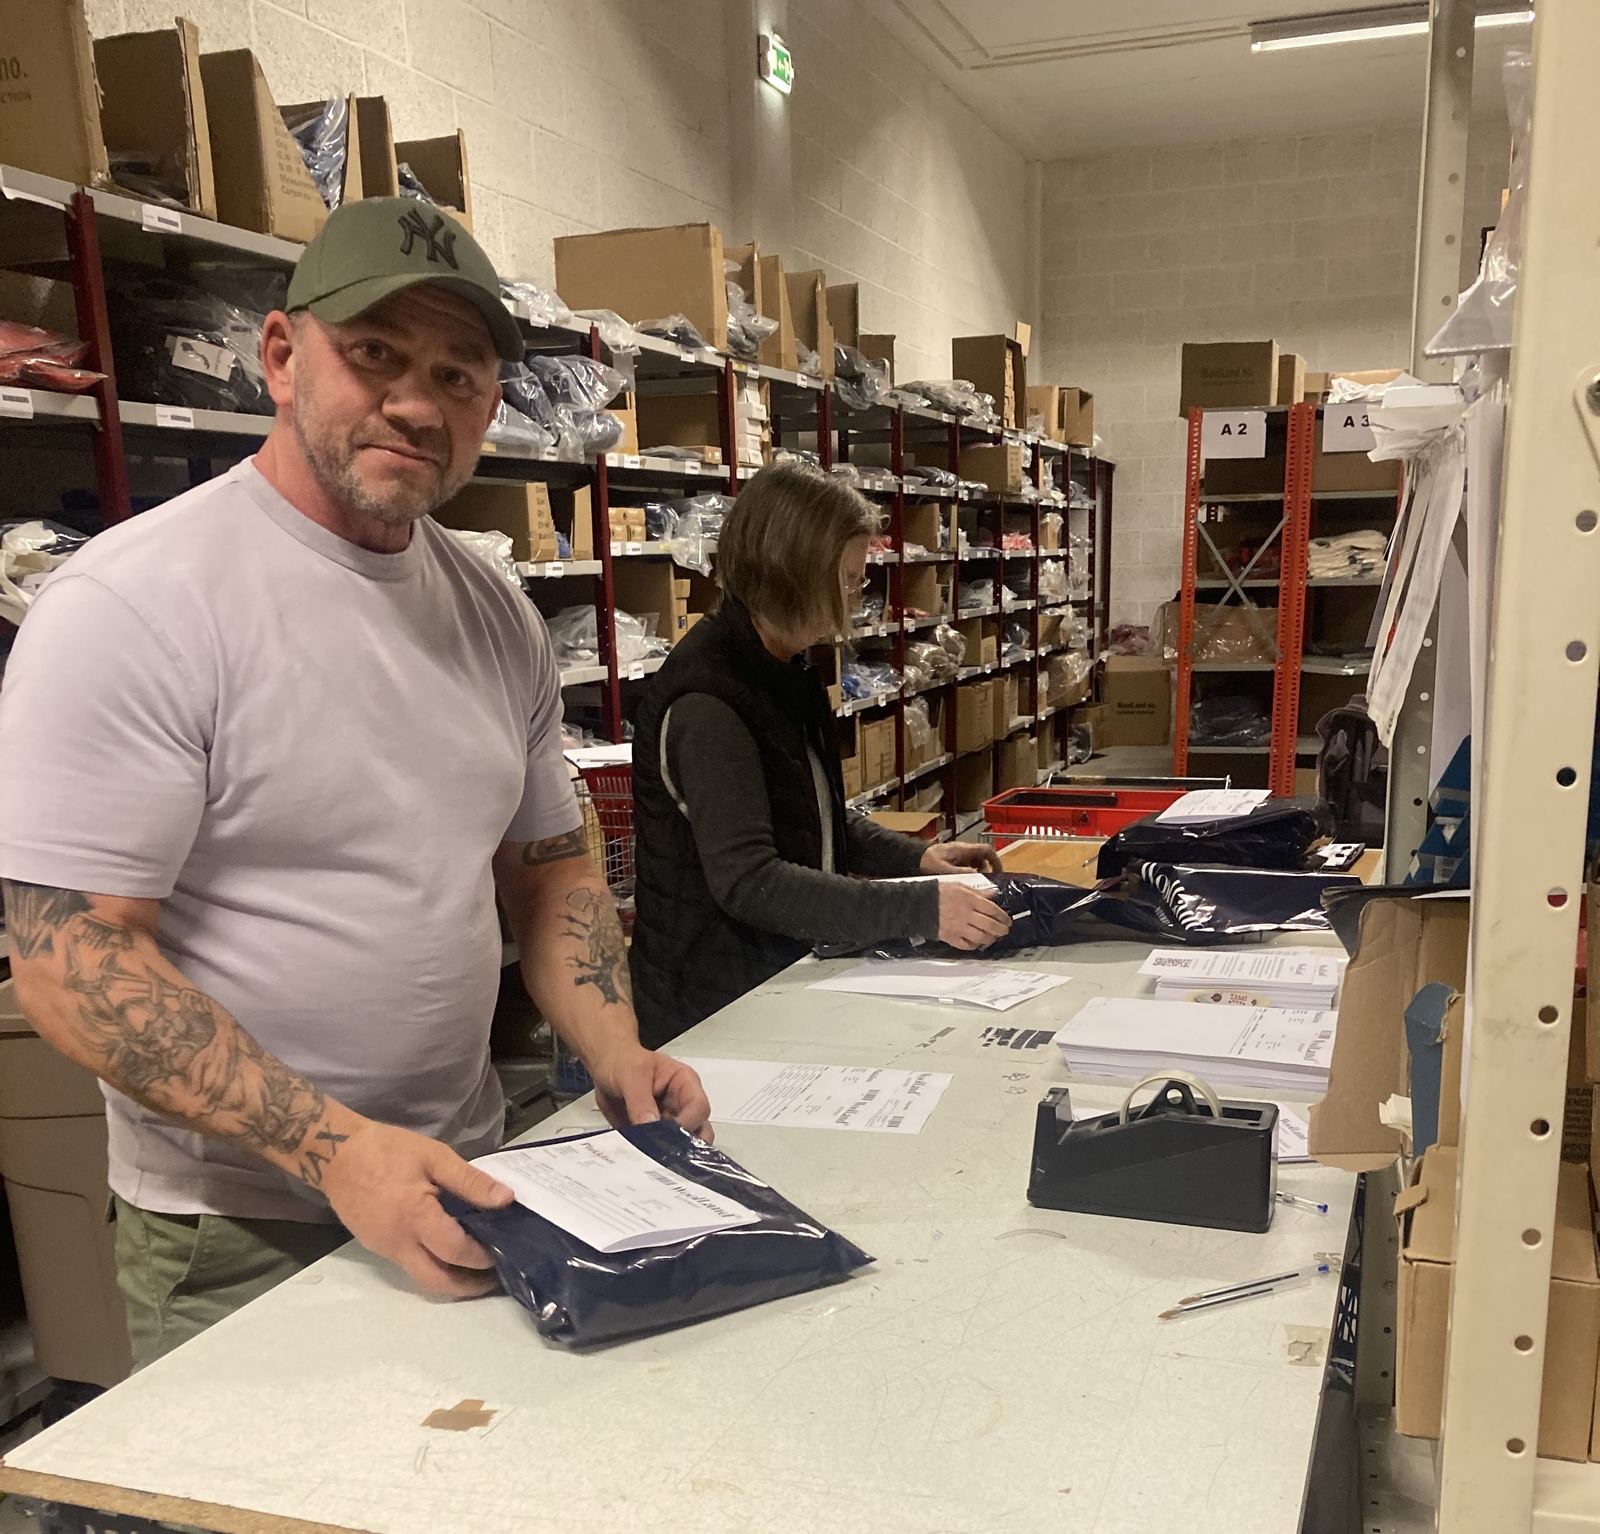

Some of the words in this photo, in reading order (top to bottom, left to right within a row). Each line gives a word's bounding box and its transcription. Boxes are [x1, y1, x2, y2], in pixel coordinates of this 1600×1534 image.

[398, 207, 458, 270] NY
[1343, 415, 1355, 428] A
[1361, 414, 1370, 427] 3
[1221, 423, 1232, 435] A
[1238, 423, 1247, 435] 2
